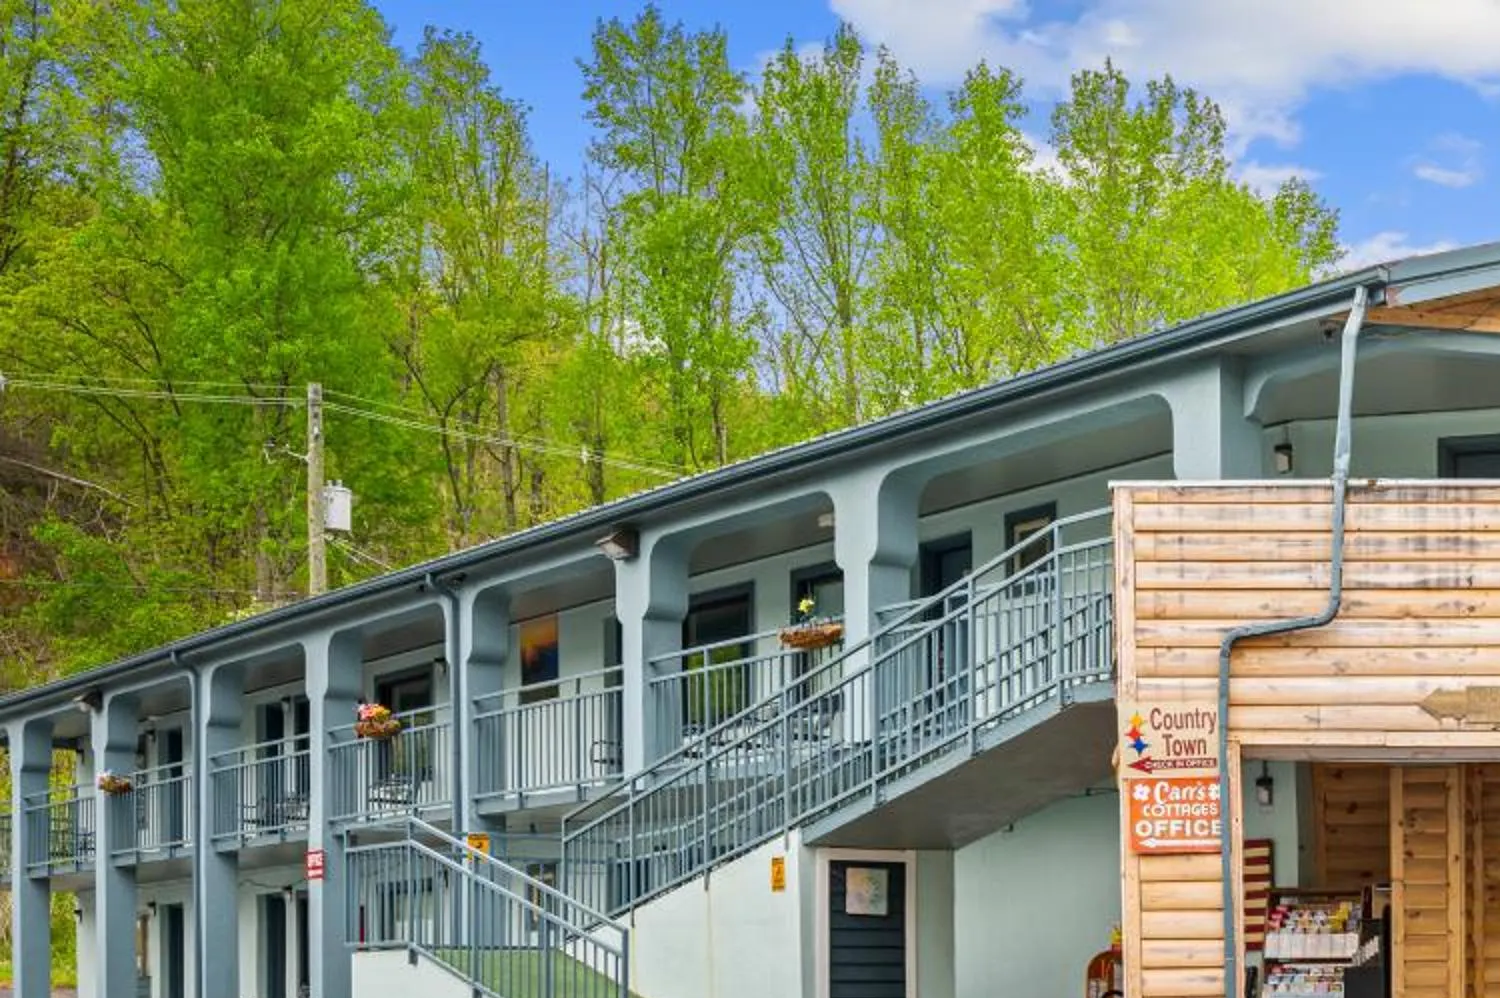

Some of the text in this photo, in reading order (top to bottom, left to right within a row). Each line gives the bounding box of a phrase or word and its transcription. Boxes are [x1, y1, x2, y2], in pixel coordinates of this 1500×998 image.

[1150, 707, 1217, 734] Country
[1162, 734, 1207, 757] Town
[1143, 803, 1219, 817] COTTAGES
[1135, 819, 1222, 837] OFFICE
